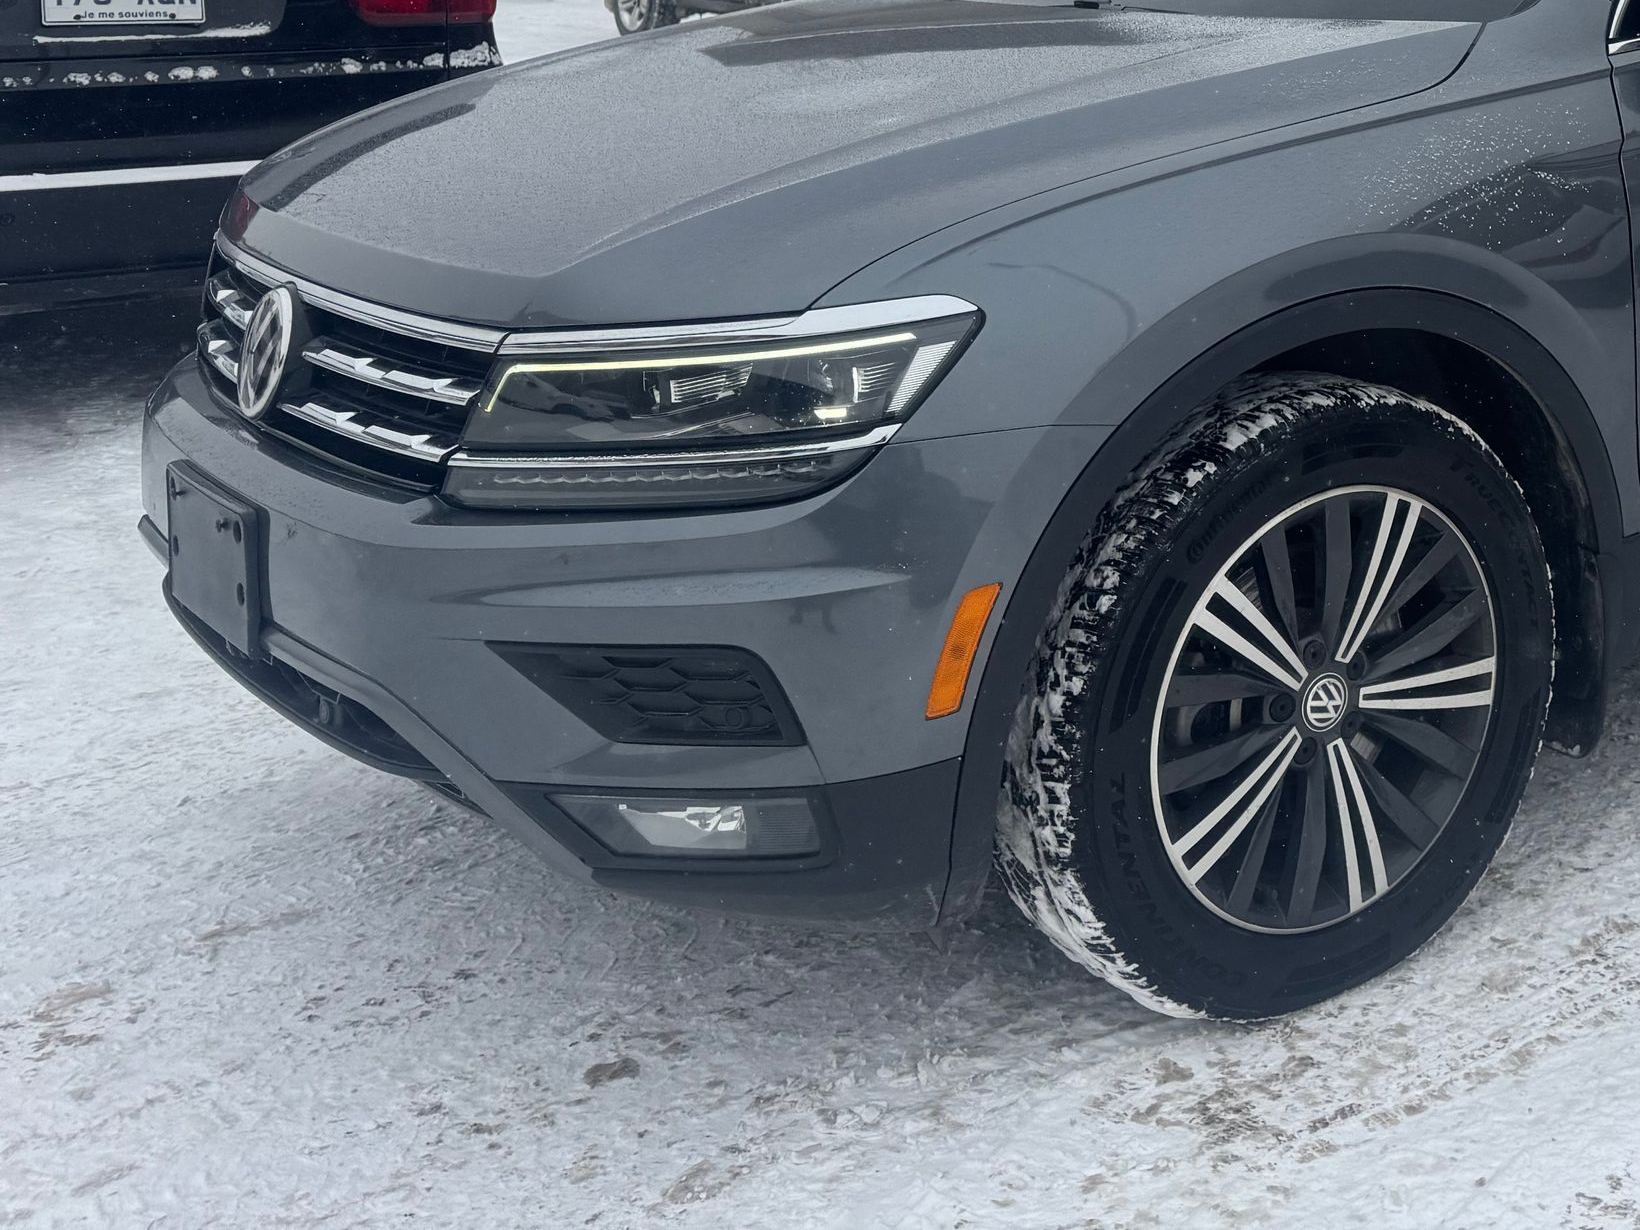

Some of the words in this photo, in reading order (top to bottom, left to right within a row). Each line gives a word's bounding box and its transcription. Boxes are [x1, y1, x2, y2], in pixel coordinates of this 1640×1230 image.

[81, 11, 95, 19] Je
[98, 11, 115, 19] me
[118, 10, 168, 18] souviens
